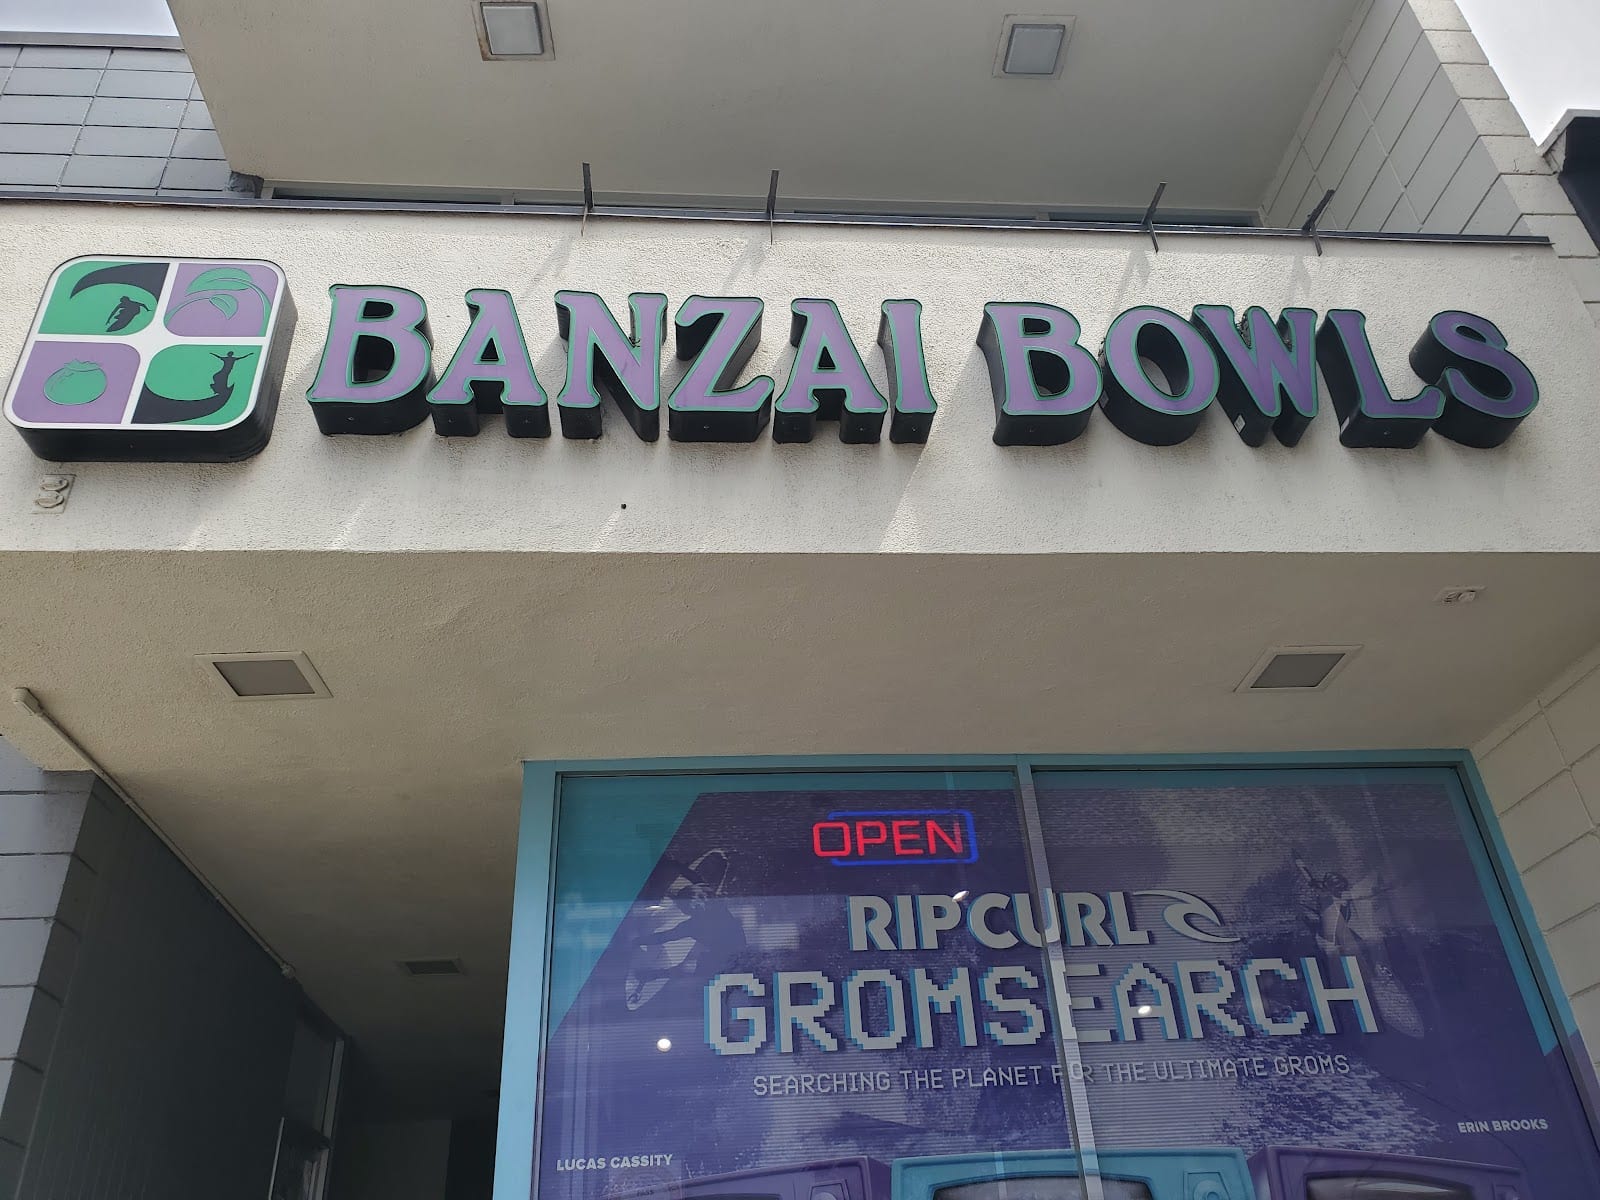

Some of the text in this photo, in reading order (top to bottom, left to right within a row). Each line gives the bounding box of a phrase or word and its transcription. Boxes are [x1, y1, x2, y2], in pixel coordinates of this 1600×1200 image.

[307, 284, 1539, 449] BANZAI BOWLS
[812, 820, 964, 859] OPEN
[752, 1054, 1350, 1097] SEARCHING THE PLANET FOR THE ULTIMATE GROMS
[1457, 1118, 1549, 1134] ERIN BROOKS
[556, 1154, 673, 1171] LUCAS CASSITY
